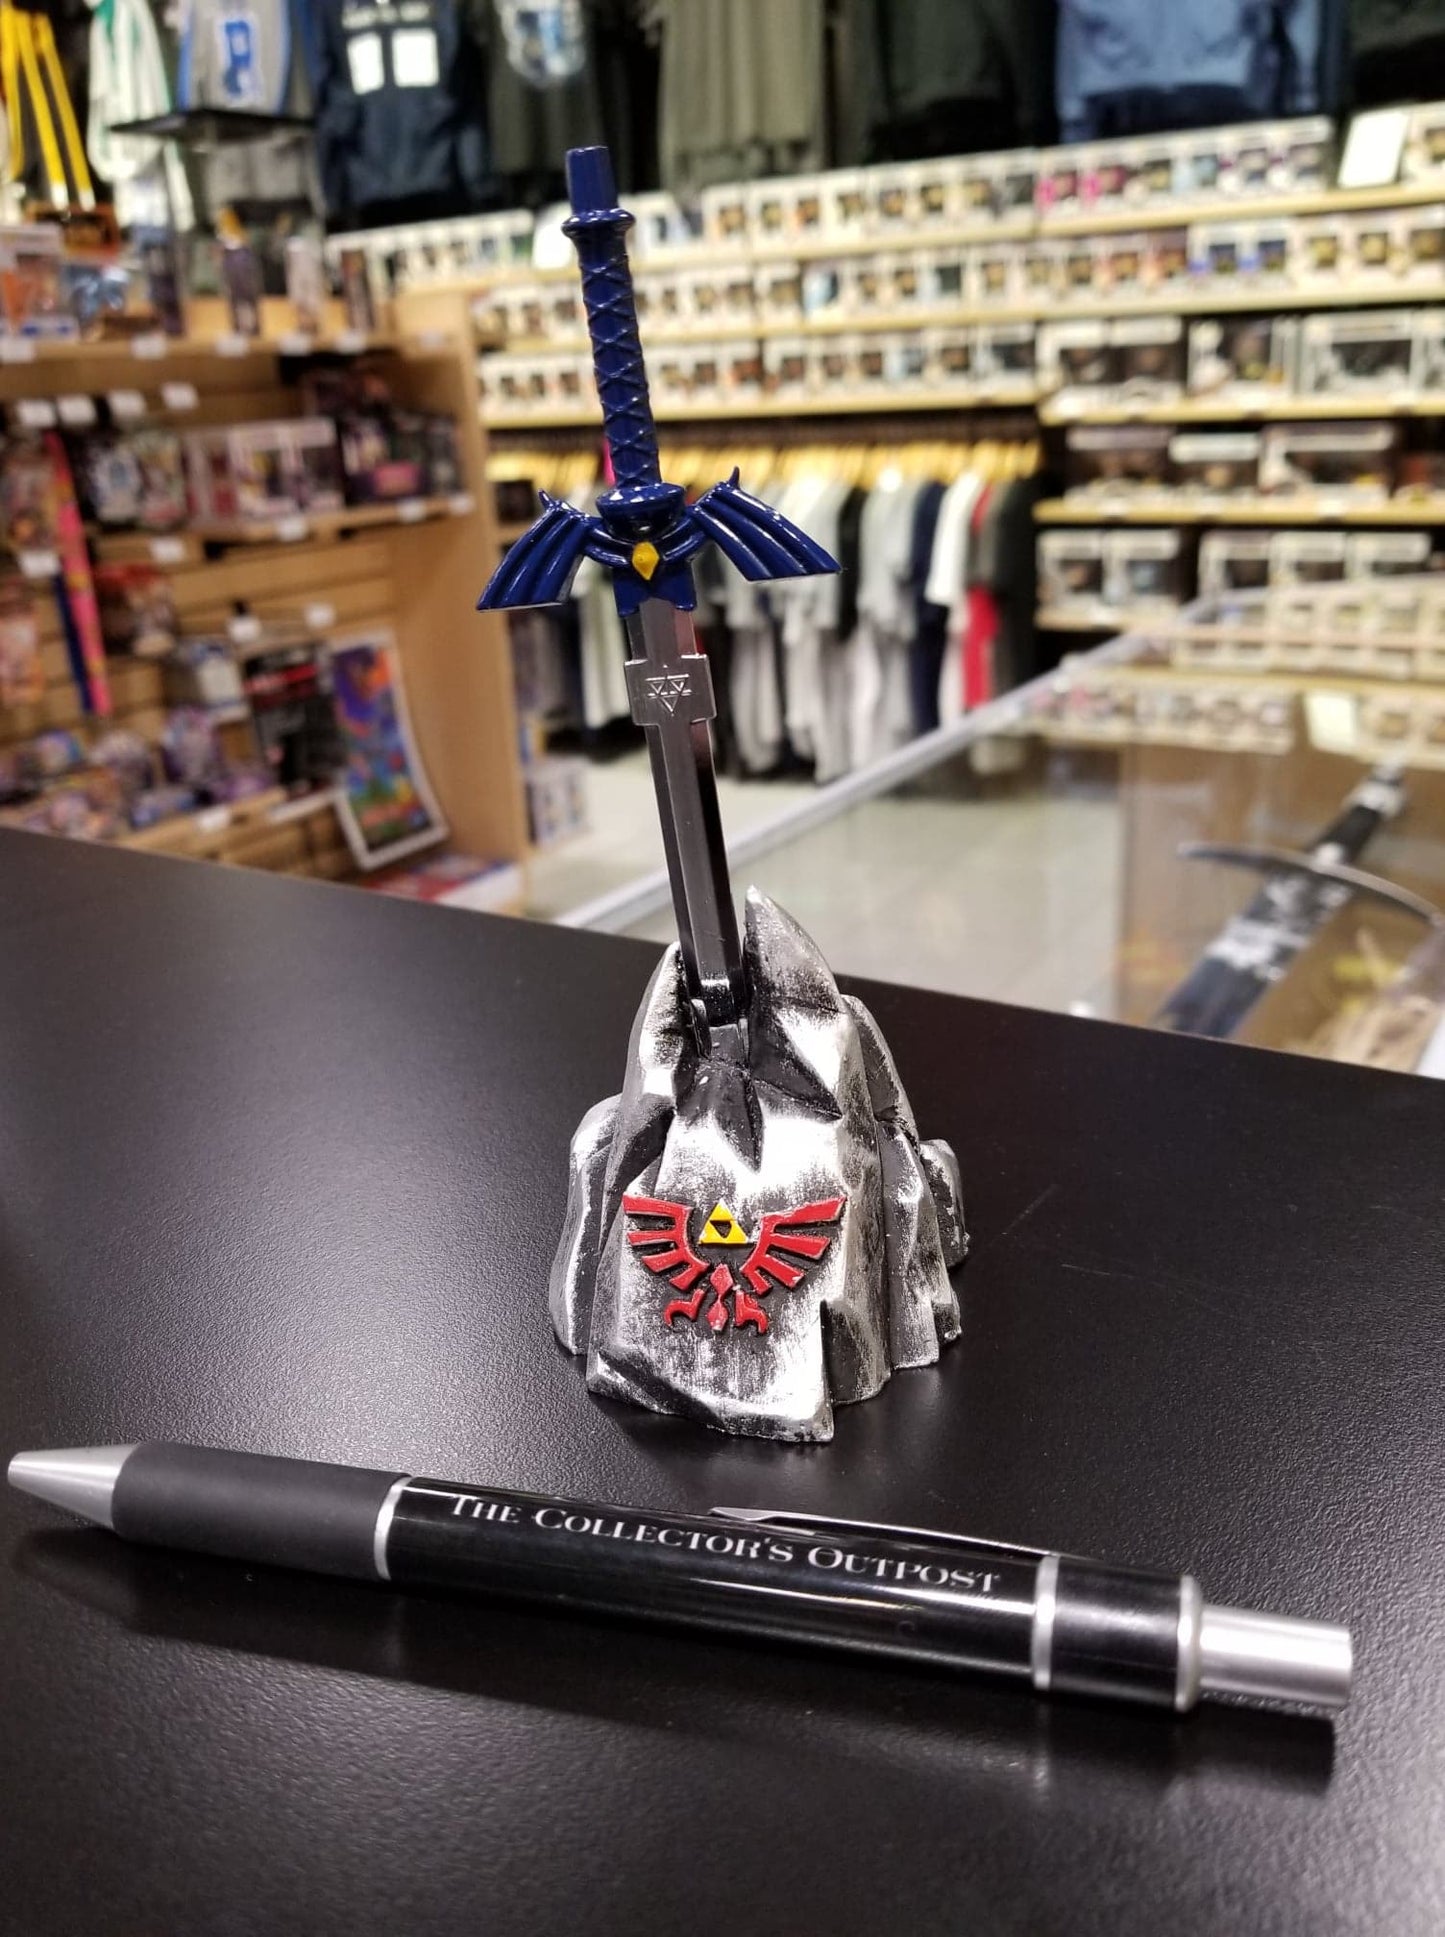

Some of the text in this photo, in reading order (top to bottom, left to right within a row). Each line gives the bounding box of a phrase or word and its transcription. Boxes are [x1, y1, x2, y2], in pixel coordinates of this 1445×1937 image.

[449, 1495, 1000, 1592] THE COLLECTOR'S OUTPOST
